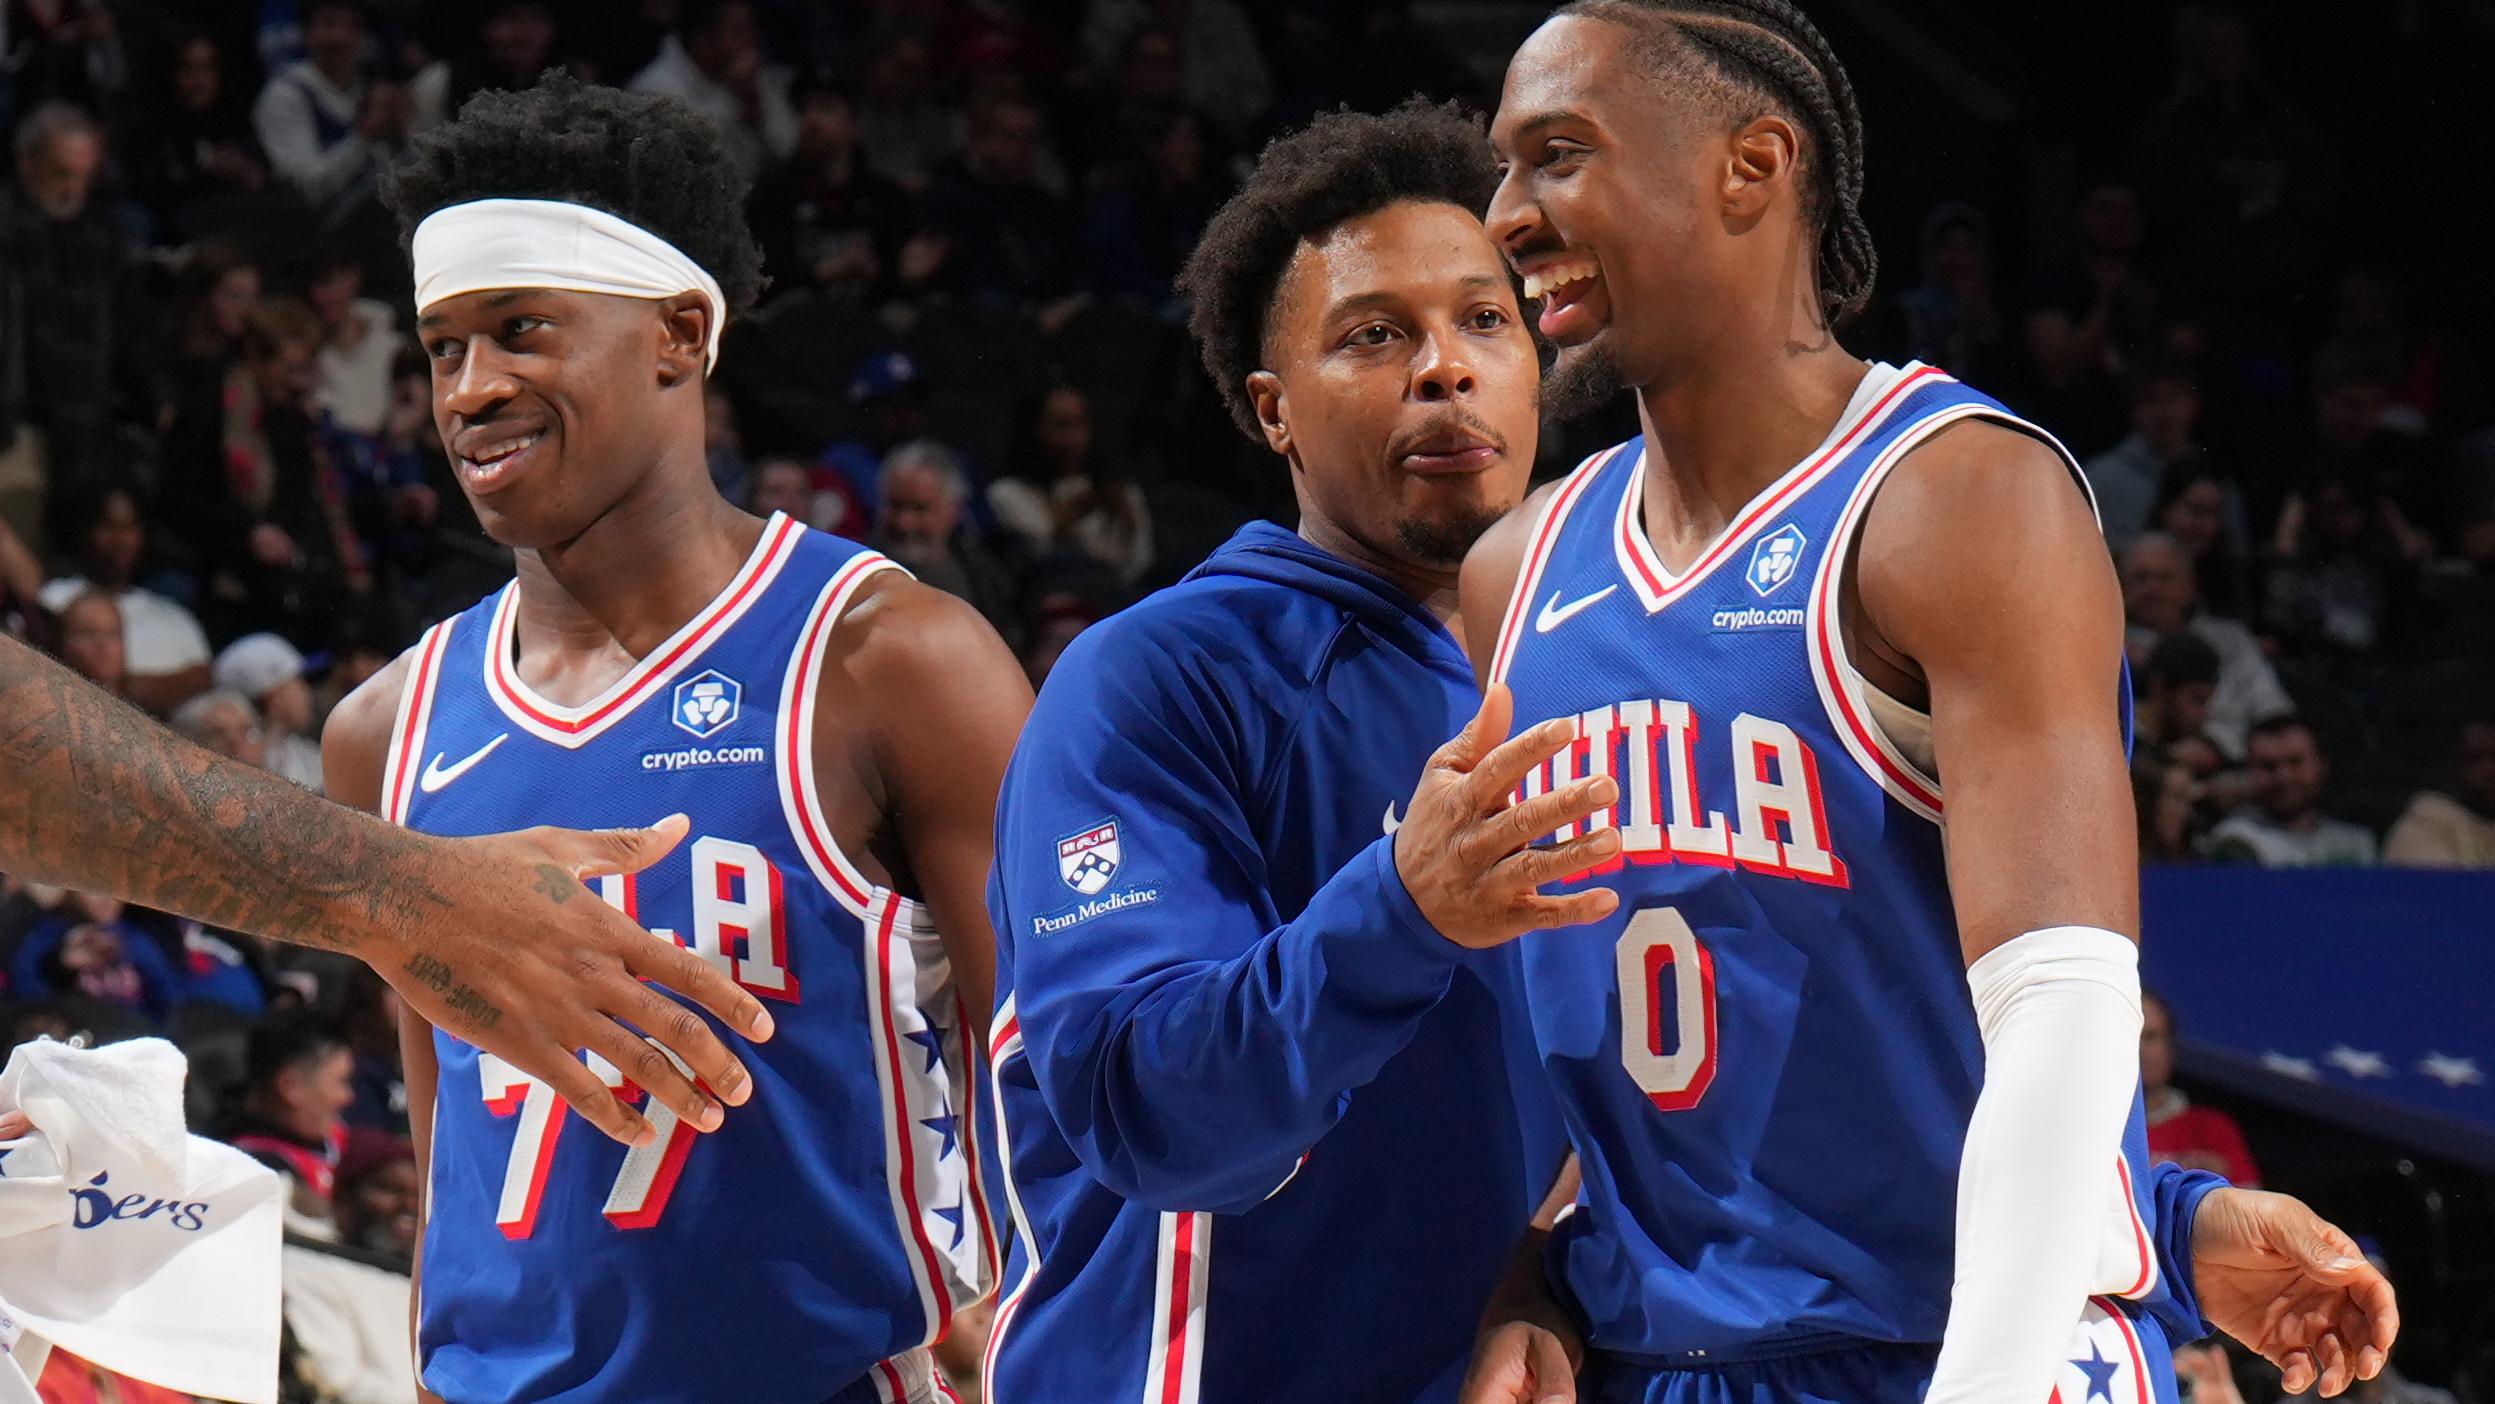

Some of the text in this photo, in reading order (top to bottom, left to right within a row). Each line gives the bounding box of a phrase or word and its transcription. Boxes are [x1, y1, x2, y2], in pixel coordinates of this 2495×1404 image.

[1712, 608, 1804, 630] crypto.com
[642, 747, 764, 771] crypto.com
[1508, 699, 1850, 889] HILA
[1033, 889, 1157, 935] Penn Medicine
[1616, 907, 1718, 1111] 0
[478, 1037, 714, 1240] 77
